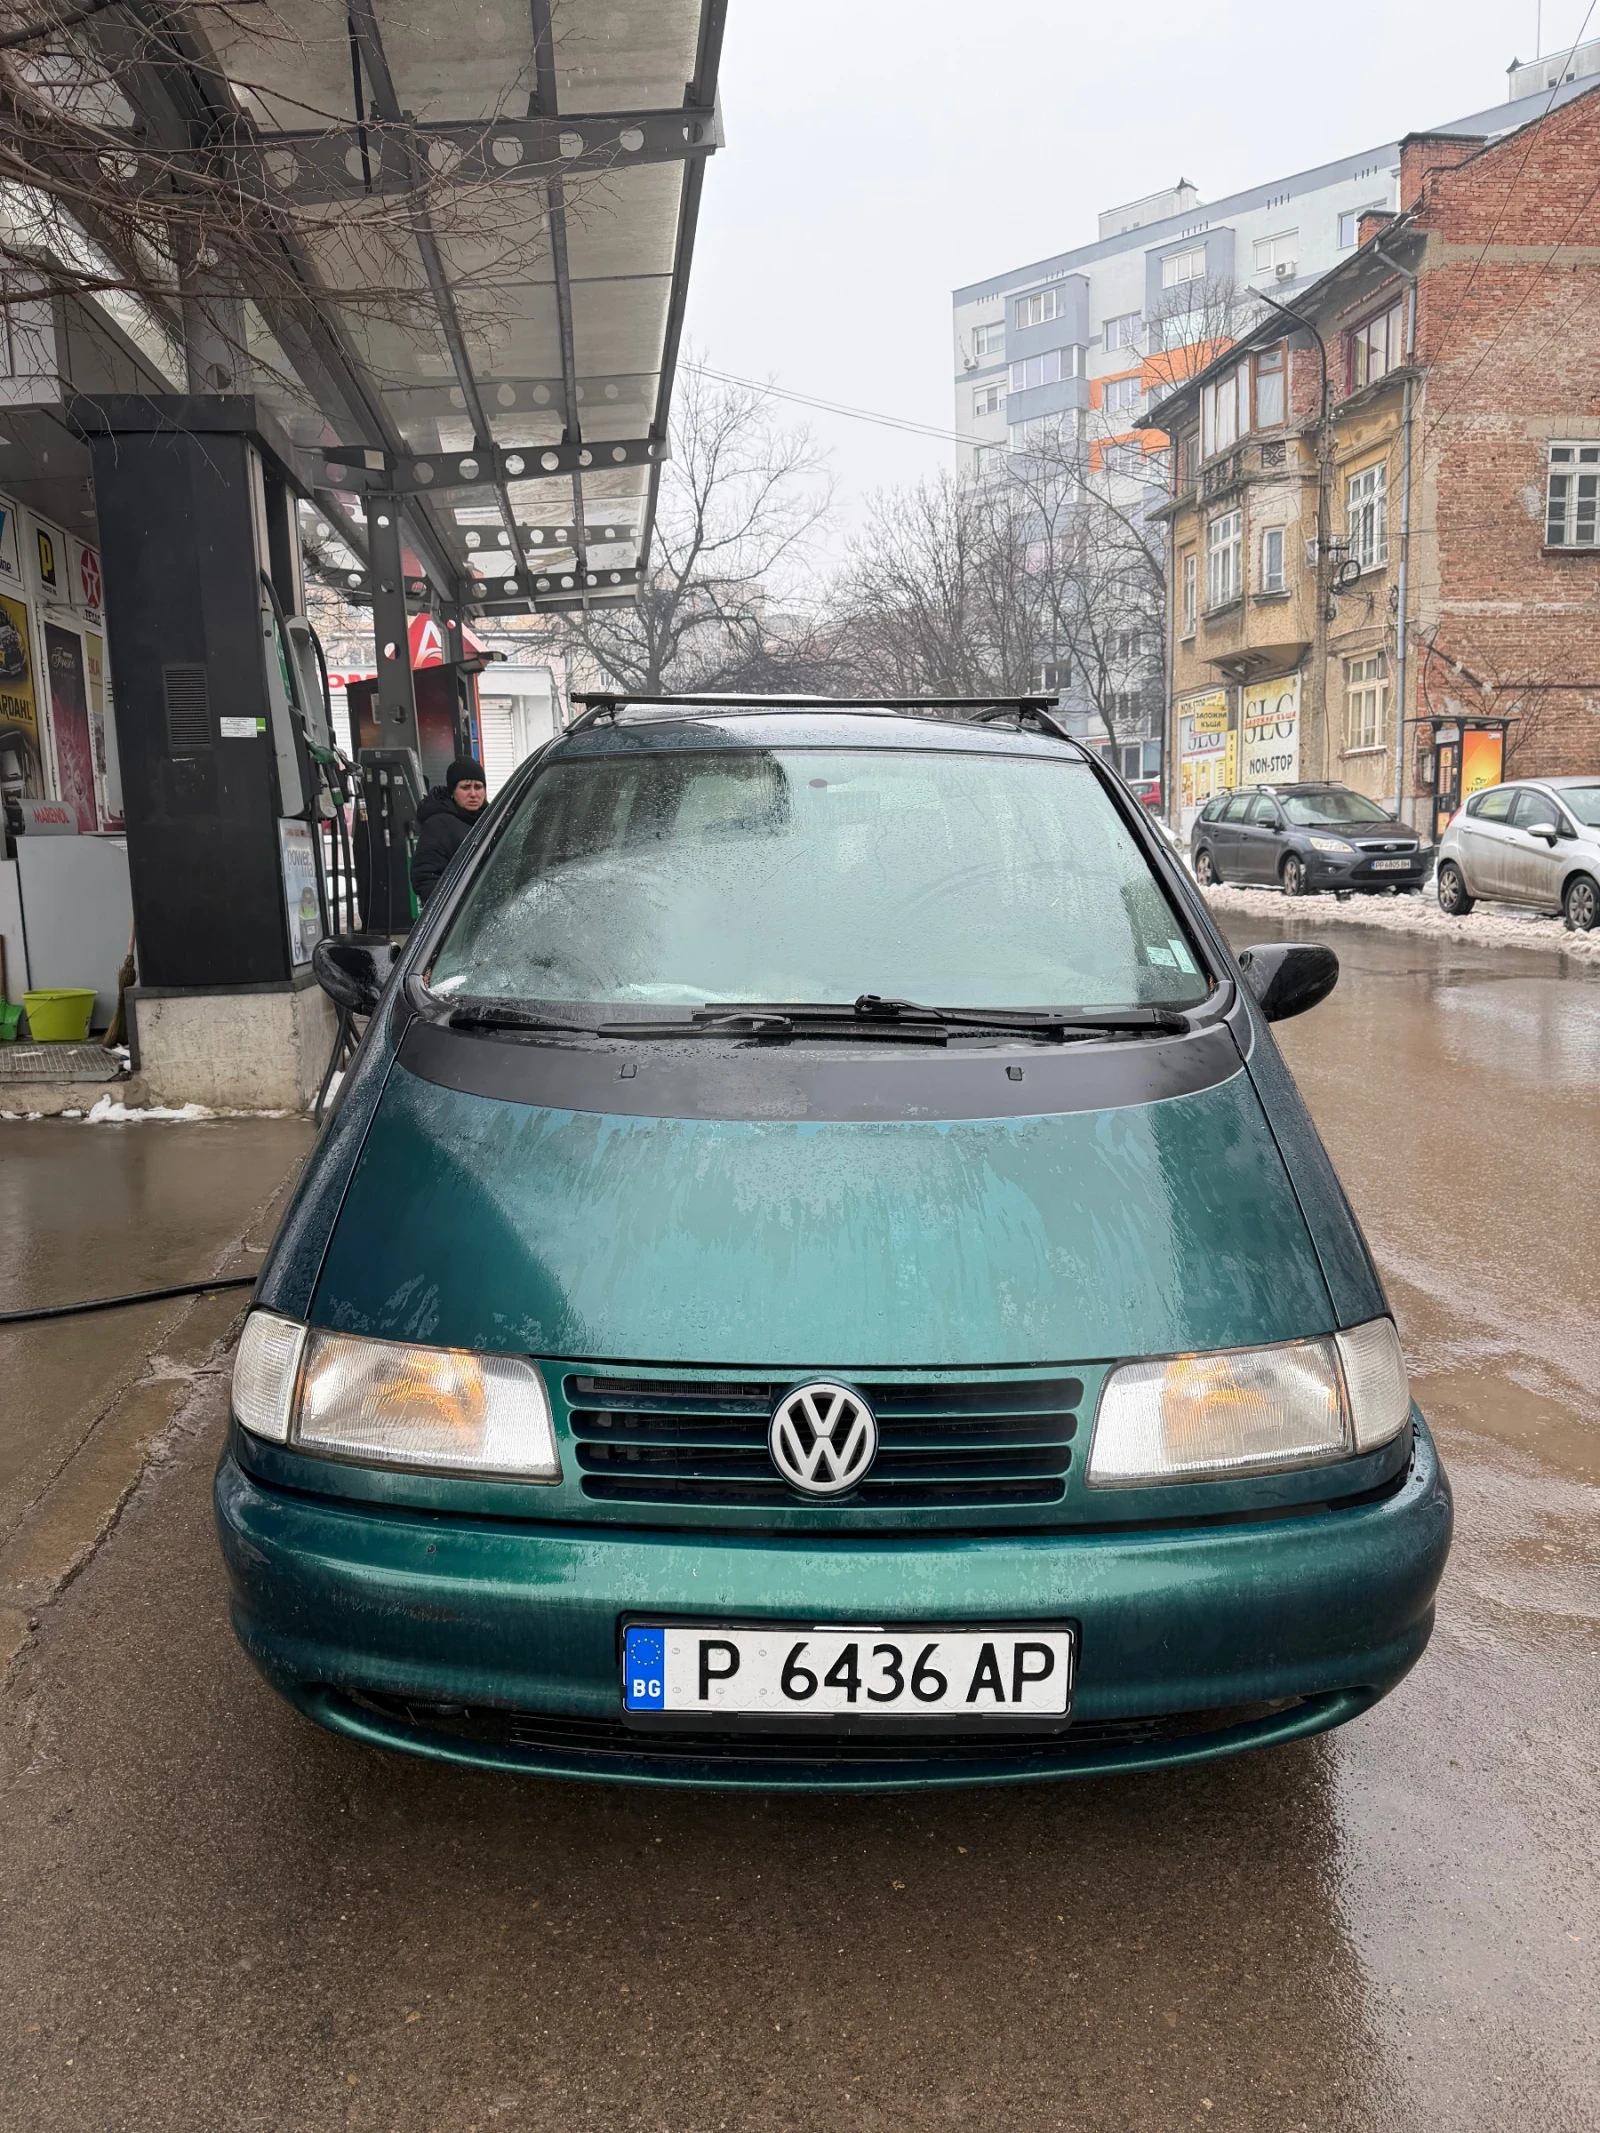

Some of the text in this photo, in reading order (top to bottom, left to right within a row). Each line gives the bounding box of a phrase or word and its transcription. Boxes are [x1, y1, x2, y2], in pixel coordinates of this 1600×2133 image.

[1249, 754, 1293, 775] NON-STOP
[698, 1640, 1055, 1703] P 6436 AP
[633, 1679, 661, 1698] BG
